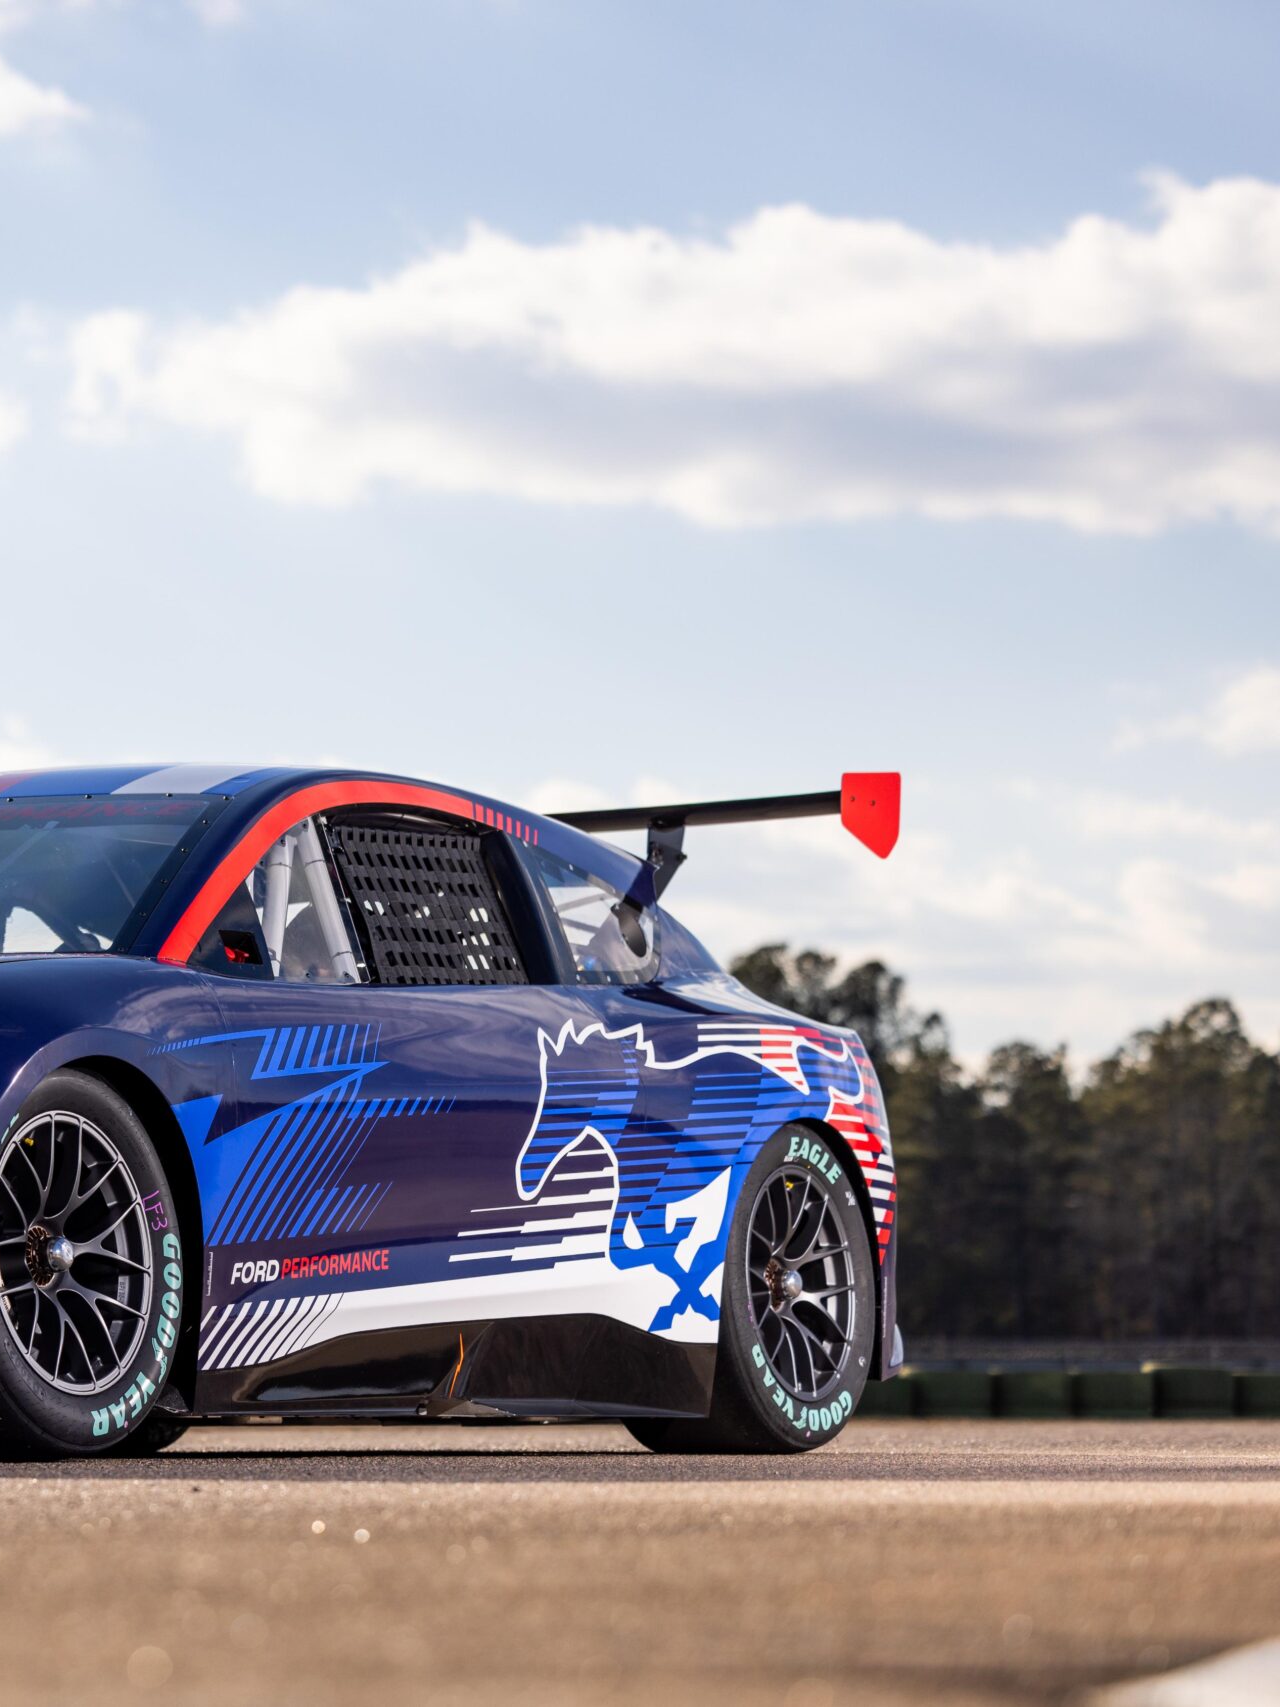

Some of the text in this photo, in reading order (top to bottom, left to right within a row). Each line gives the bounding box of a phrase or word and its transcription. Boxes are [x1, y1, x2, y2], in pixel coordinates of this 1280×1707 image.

[788, 1136, 841, 1184] EAGLE
[230, 1259, 280, 1285] FORD
[281, 1249, 390, 1280] PERFORMANCE
